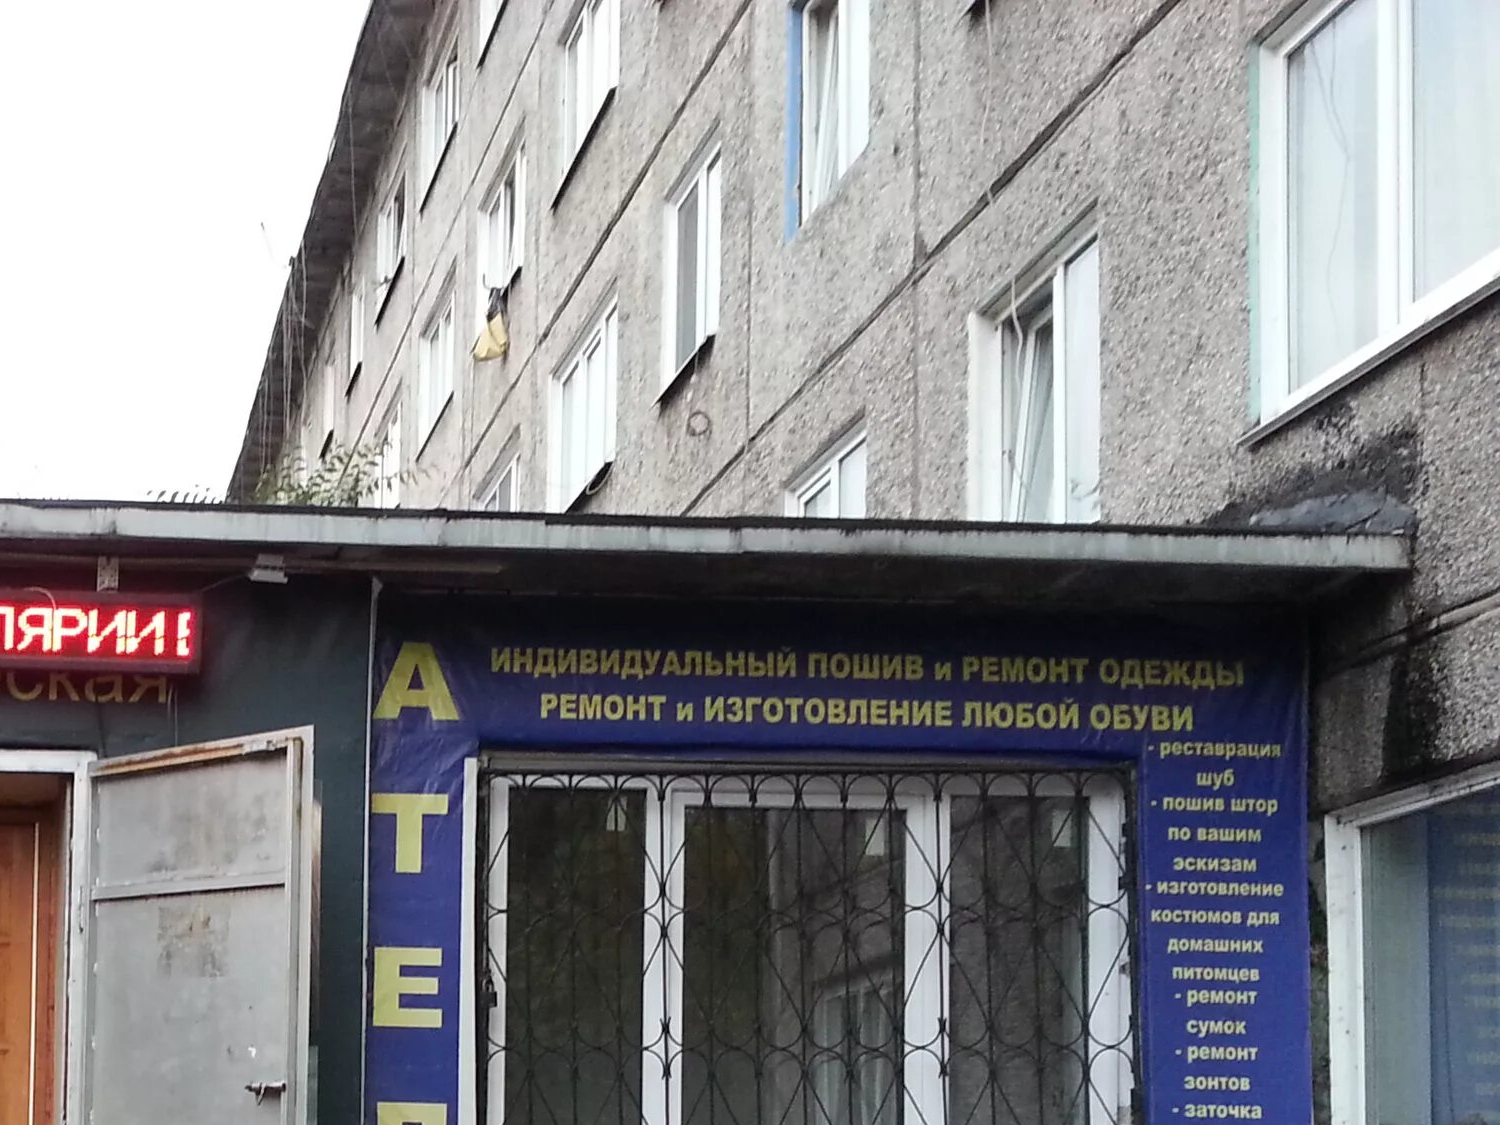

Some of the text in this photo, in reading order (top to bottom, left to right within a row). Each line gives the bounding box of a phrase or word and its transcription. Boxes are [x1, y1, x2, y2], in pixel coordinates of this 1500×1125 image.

[490, 645, 1245, 689] ИНДИВИДУАЛЬНЫЙ ПОШИВ и РЕМОНТ ОДЕЖДЫ
[540, 693, 1193, 732] РЕМОНТ и ИЗГОТОВЛЕНИЕ ЛЮБОЙ ОБУВИ
[1160, 741, 1281, 760] реставрация
[1196, 769, 1235, 791] шуб
[1163, 797, 1225, 811] пошив
[1231, 798, 1278, 816] штор
[1167, 826, 1261, 843] по вашим
[1173, 857, 1257, 872] эскизам
[1156, 881, 1284, 897] изготовление
[1150, 909, 1280, 927] костюмов для
[1167, 938, 1264, 954] домашних
[1172, 965, 1260, 982] питомцев
[1187, 990, 1258, 1007] ремонт
[1186, 1019, 1246, 1037] сумок
[1187, 1045, 1258, 1064] ремонт
[1184, 1075, 1251, 1091] зонтов
[1184, 1103, 1262, 1119] заточка
